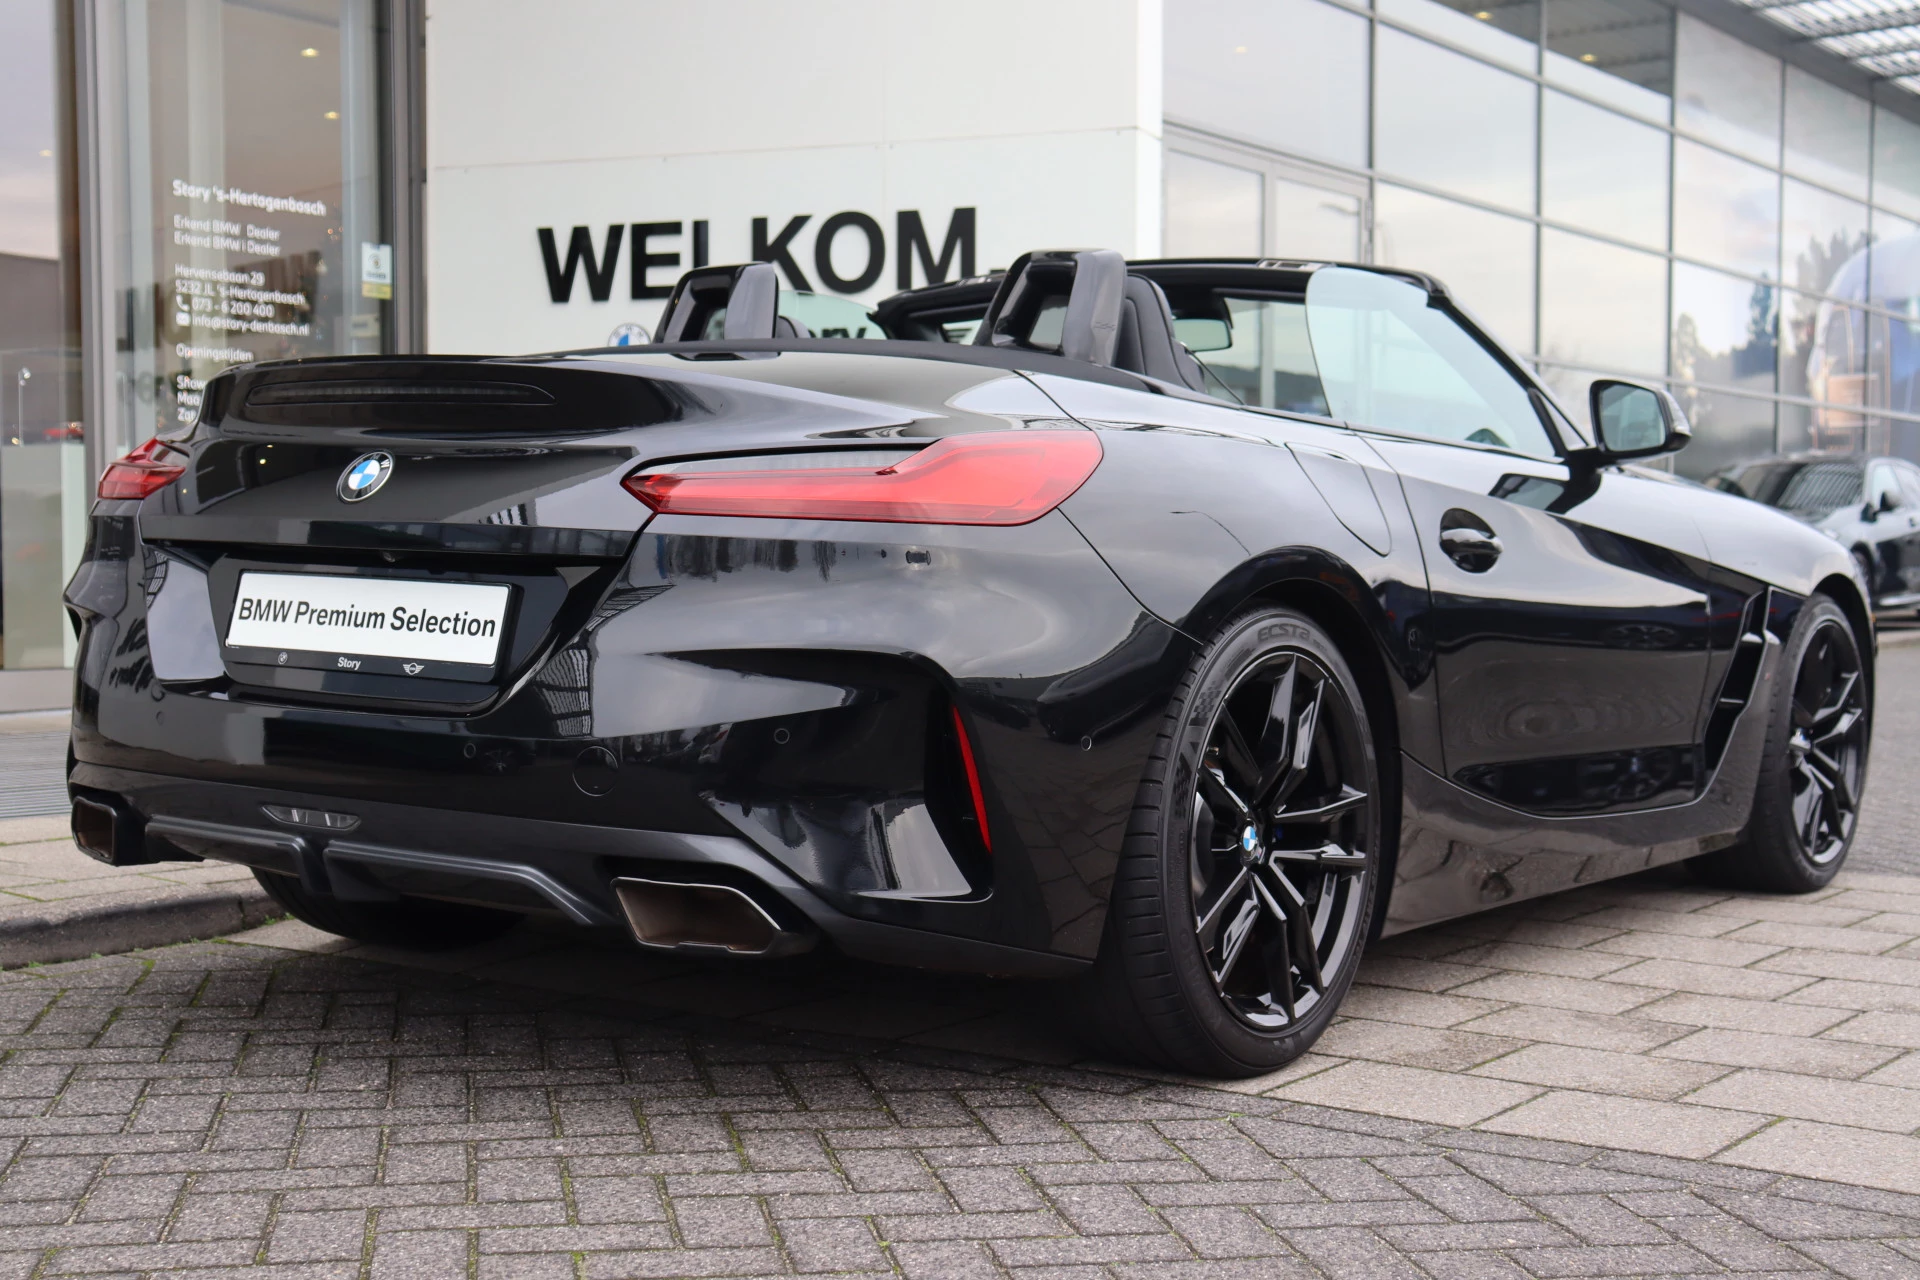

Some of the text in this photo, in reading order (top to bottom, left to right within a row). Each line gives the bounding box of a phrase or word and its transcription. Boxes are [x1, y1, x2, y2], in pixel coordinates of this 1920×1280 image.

[173, 179, 326, 216] Story 's-Hertogenbosch
[174, 215, 280, 240] Erkend BMW Dealer
[174, 232, 210, 248] Erkend
[213, 236, 240, 250] BMW
[247, 241, 280, 256] Dealer
[175, 264, 265, 286] Hervensebaan 29
[175, 279, 306, 305] 5232 JL 's-Hertogenbosch
[192, 298, 212, 311] 073
[221, 303, 228, 314] 6
[230, 304, 250, 316] 200
[253, 305, 275, 318] 400
[192, 312, 309, 336] info@story-denbosch.nl
[176, 343, 253, 362] Openingstijden
[239, 598, 496, 637] BMW Premium Selection
[337, 656, 361, 670] Story
